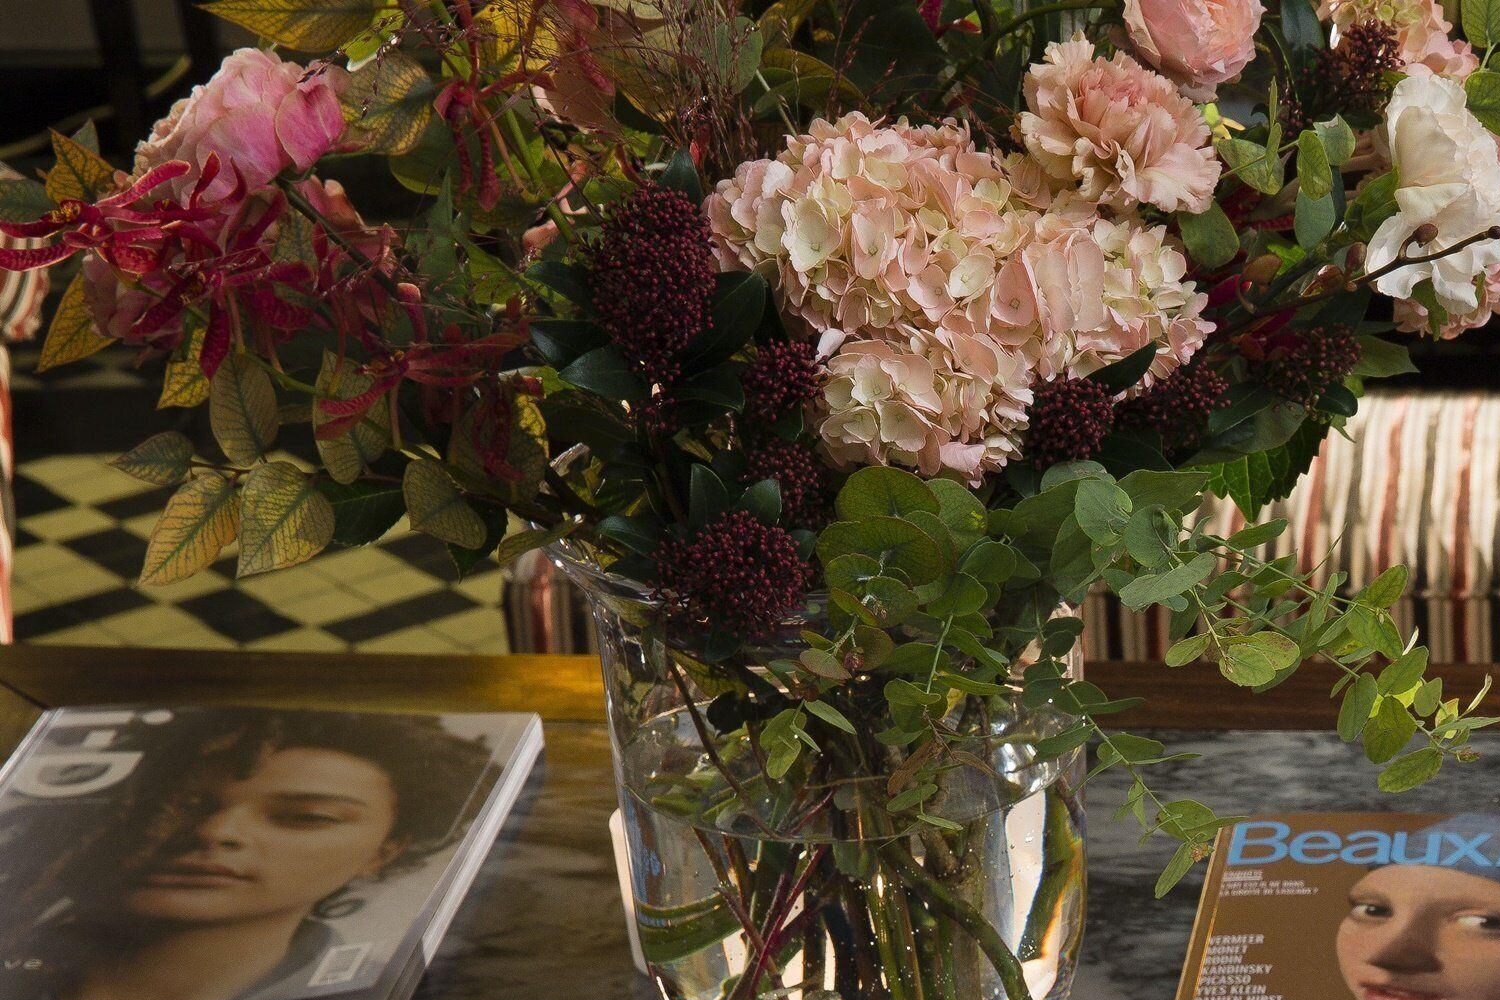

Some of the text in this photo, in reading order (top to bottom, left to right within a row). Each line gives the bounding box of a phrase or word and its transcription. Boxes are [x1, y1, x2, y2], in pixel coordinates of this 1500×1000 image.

[1226, 820, 1493, 867] Beaux
[1210, 934, 1264, 945] VERMEER
[1207, 945, 1248, 955] MONET
[1202, 964, 1273, 975] KANDINSKY
[1199, 974, 1252, 985] PICASSO
[1197, 984, 1267, 996] YVES KLEIN
